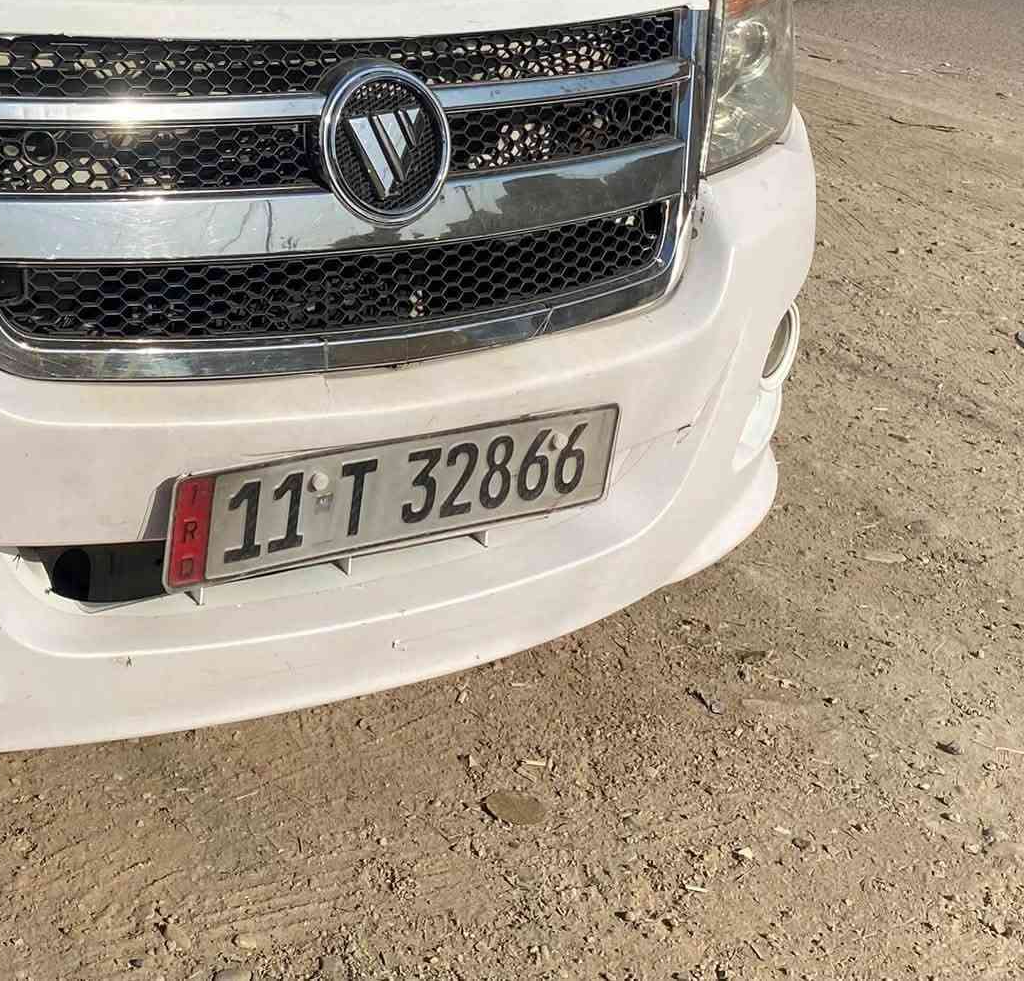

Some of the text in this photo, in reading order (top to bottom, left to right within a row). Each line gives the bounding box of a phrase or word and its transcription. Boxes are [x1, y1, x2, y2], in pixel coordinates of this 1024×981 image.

[223, 423, 589, 564] 11 T 32866
